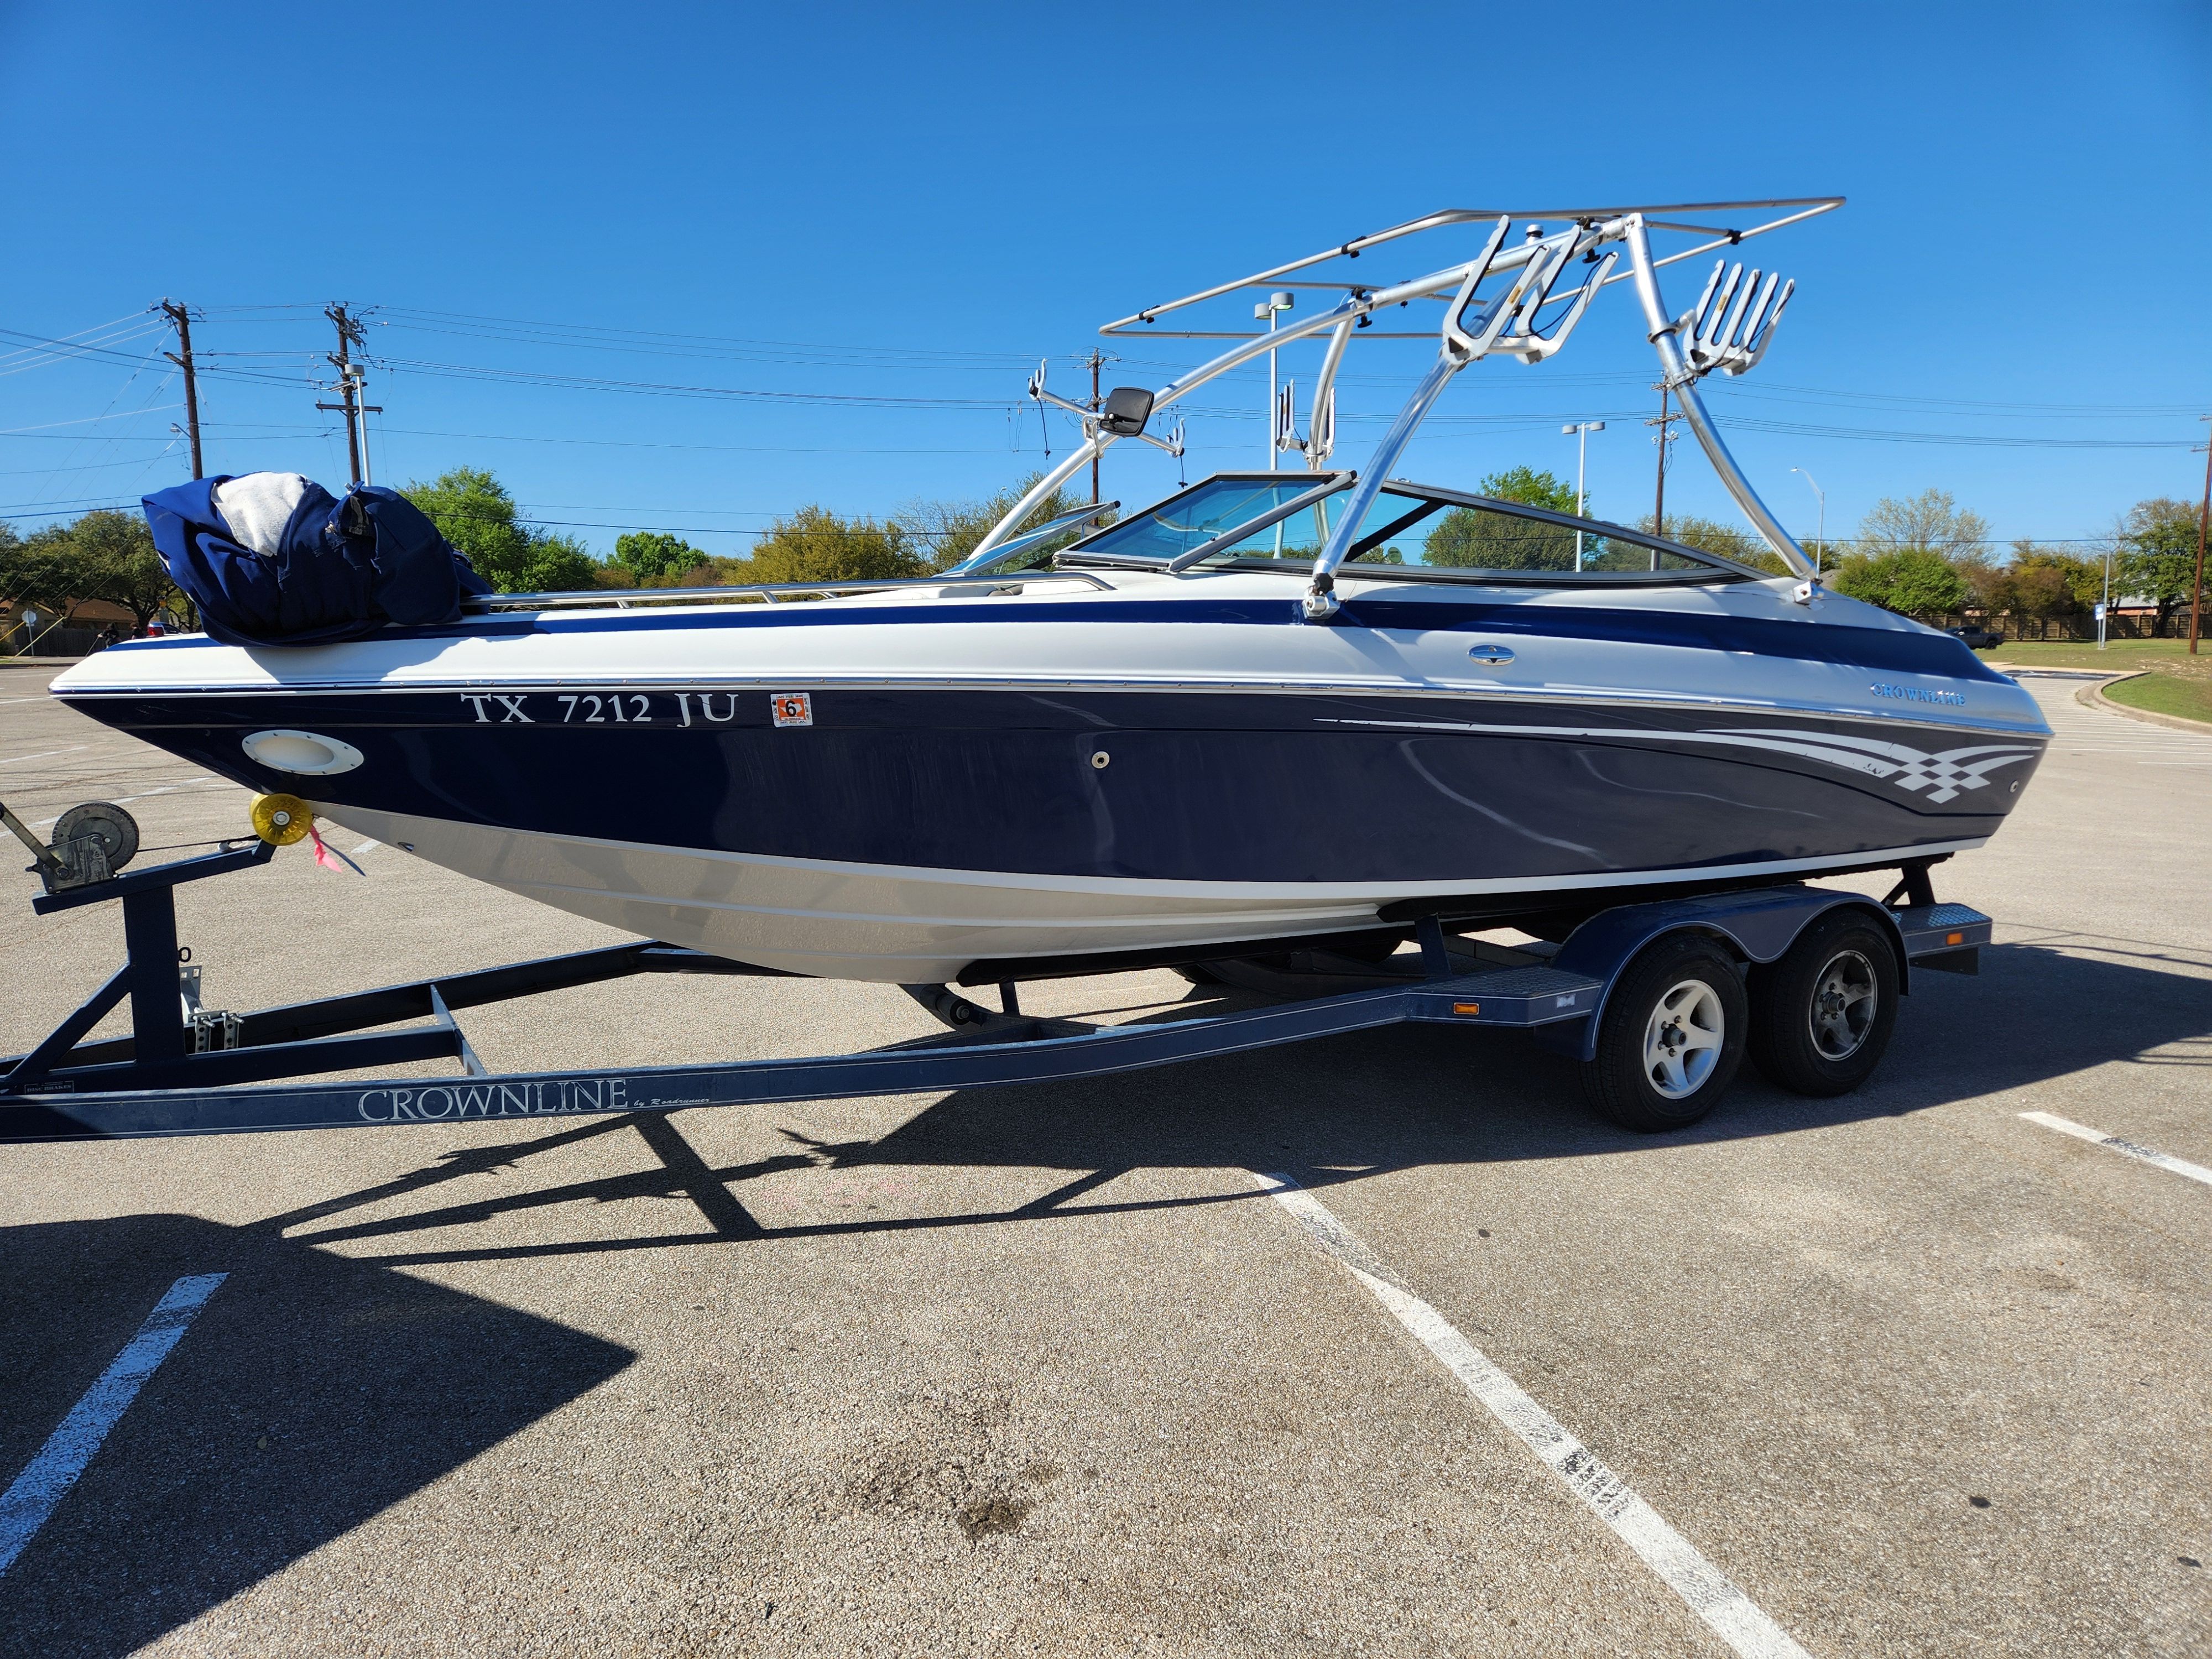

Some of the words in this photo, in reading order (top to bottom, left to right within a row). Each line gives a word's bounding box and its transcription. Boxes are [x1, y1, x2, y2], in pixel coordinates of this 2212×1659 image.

[785, 700, 797, 717] 6
[1870, 682, 1966, 707] CROWNLINE
[461, 693, 535, 723] TX
[557, 695, 652, 723] 7212
[674, 692, 739, 728] JU
[358, 1078, 629, 1121] CROWNLINE
[633, 1099, 645, 1108] by
